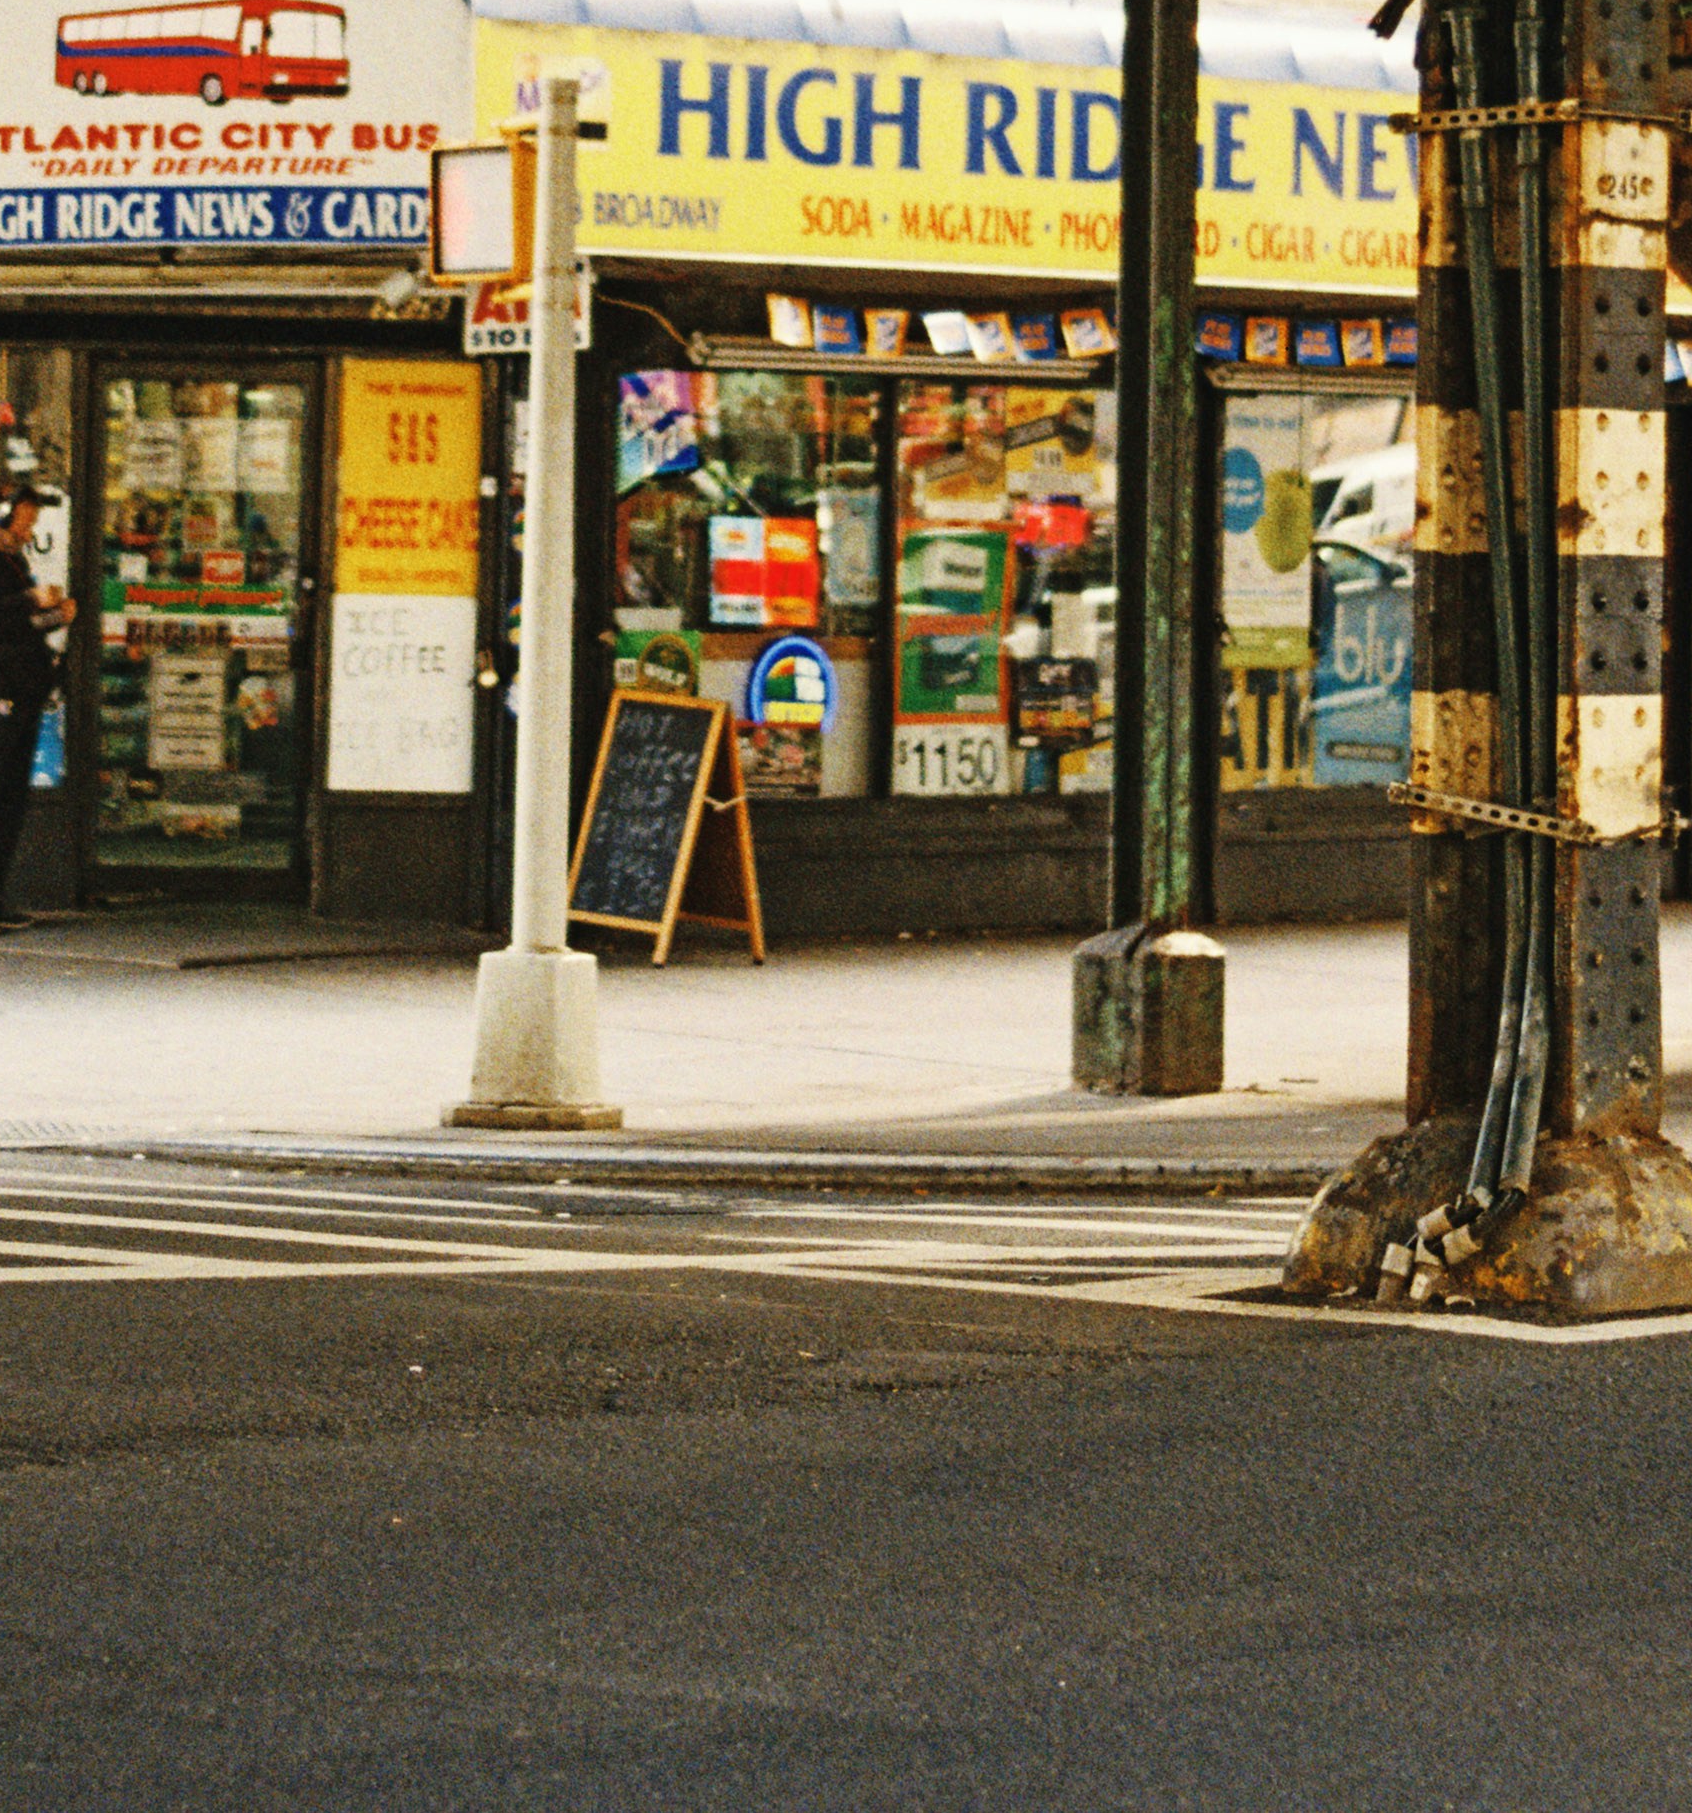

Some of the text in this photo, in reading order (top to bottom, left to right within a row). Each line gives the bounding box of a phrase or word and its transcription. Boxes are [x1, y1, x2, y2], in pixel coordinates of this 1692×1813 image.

[220, 123, 336, 153] CITY
[351, 124, 440, 153] BUS
[658, 58, 921, 171] HIGH
[963, 80, 1256, 194] RIDE
[56, 193, 164, 241] RIDGE
[175, 191, 276, 240] NEWS
[321, 191, 430, 238] CARD
[594, 190, 723, 232] BROADWAY
[801, 194, 874, 238] SODA
[899, 201, 1035, 249] MAGAZINE
[1246, 221, 1316, 263] CIGAR
[1334, 601, 1407, 688] blu
